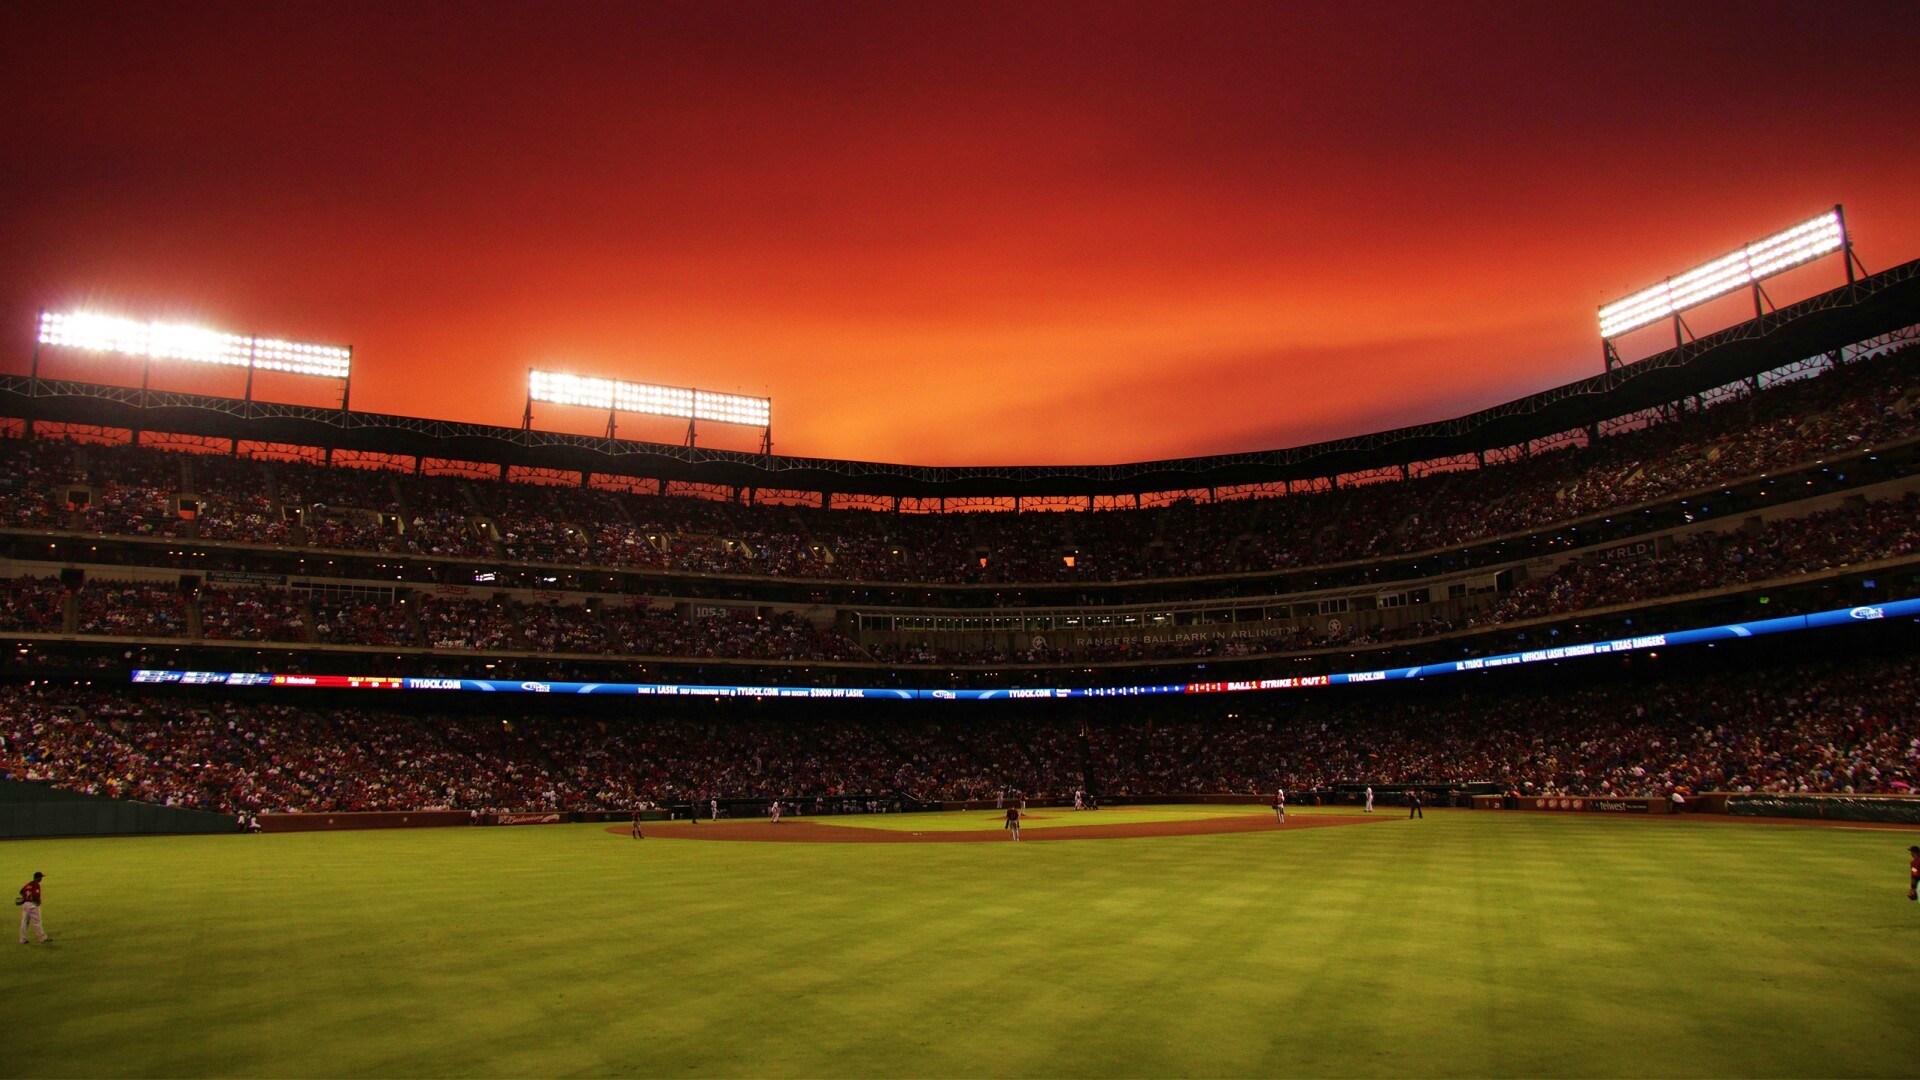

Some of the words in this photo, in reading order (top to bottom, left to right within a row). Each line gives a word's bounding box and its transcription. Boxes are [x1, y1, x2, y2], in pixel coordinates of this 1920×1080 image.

[1606, 543, 1646, 560] KRLD
[1076, 636, 1138, 646] RANGERS
[1143, 632, 1208, 644] BALLPARK
[1212, 631, 1226, 639] IN
[1230, 625, 1300, 638] ARLINGTON
[1521, 650, 1547, 662] OFFICIAL
[1547, 648, 1564, 659] LASIK
[1564, 644, 1594, 656] SURGEON
[1611, 640, 1632, 650] TEXAS
[1632, 635, 1666, 648] RANGERS
[1301, 676, 1320, 686] OUT
[1320, 676, 1327, 685] 2
[1347, 671, 1386, 682] TYLOCK.COM
[410, 679, 461, 690] TYLOCK.COM
[1227, 682, 1251, 690] BALL
[1251, 680, 1257, 689] 1
[1260, 679, 1291, 689] STRIKE
[1292, 677, 1299, 687] 1
[657, 685, 678, 694] LASIK
[737, 687, 779, 696] TYLOCK.COM
[810, 688, 831, 697] $2000
[832, 689, 844, 697] OFF
[1008, 689, 1051, 698] TYLOCK.COM
